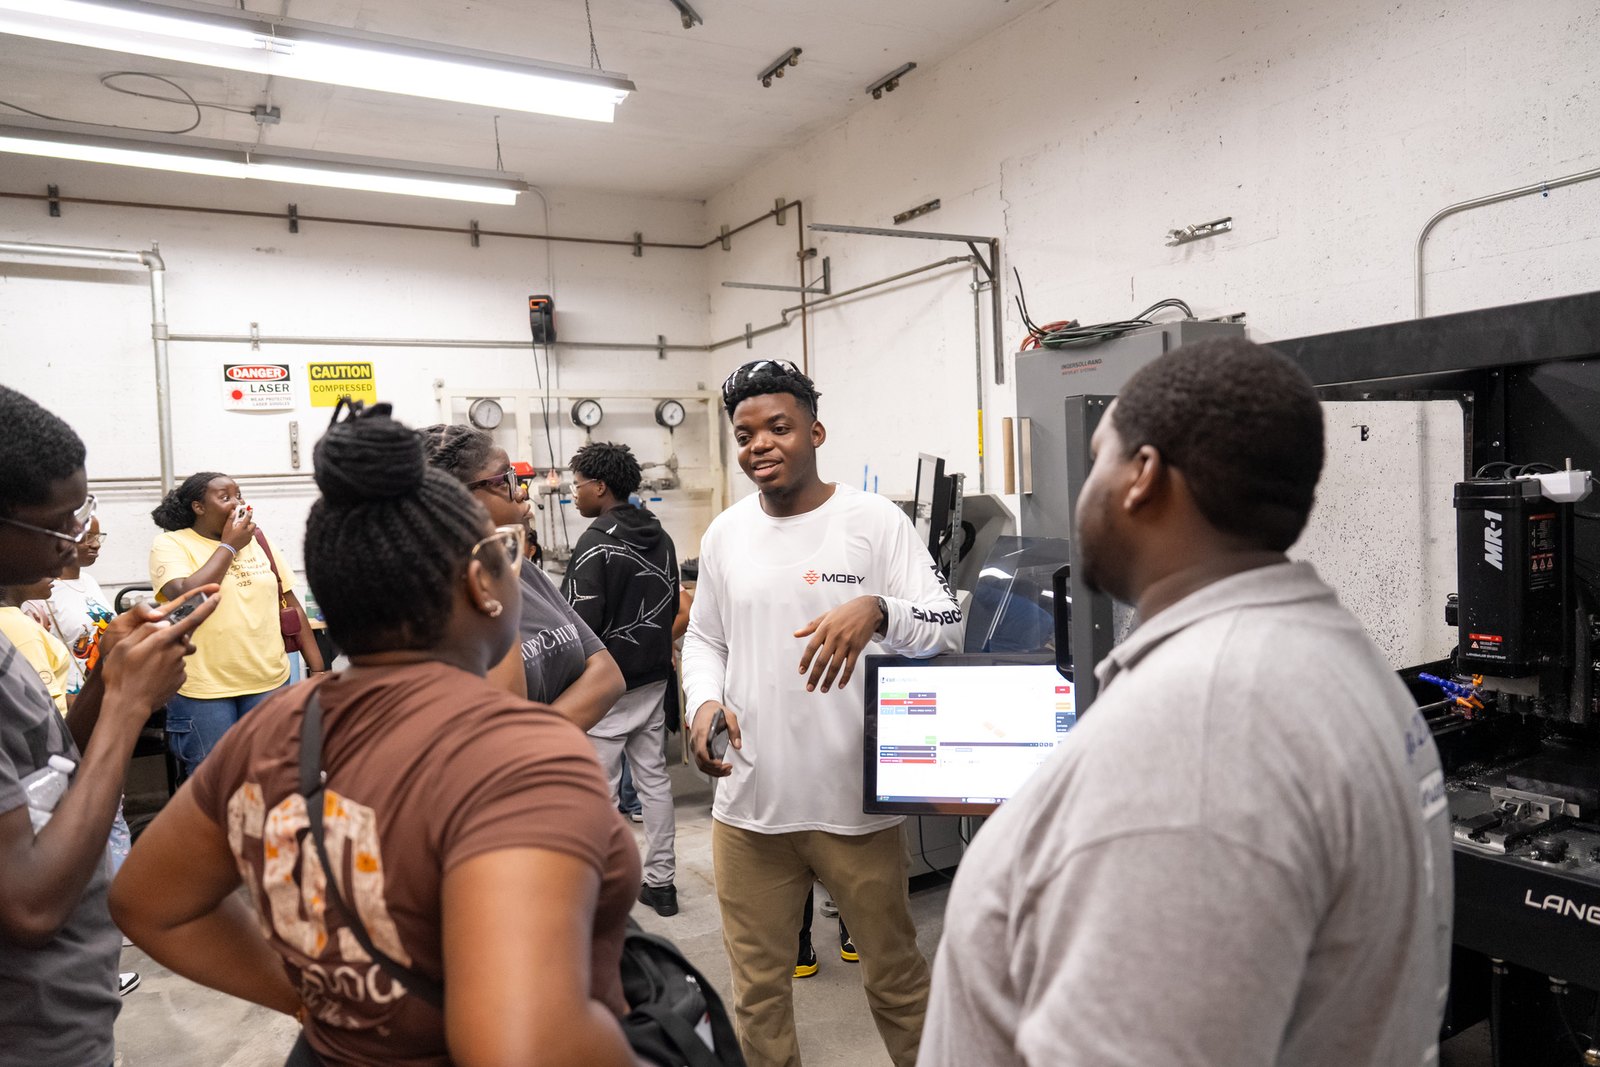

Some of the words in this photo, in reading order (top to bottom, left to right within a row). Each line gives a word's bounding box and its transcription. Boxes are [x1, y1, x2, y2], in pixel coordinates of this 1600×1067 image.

[233, 367, 282, 379] DANGER
[312, 365, 371, 379] CAUTION
[250, 383, 290, 393] LASER
[313, 384, 373, 393] COMPRESSED
[1484, 509, 1503, 571] MR-1
[821, 573, 865, 585] MOBY
